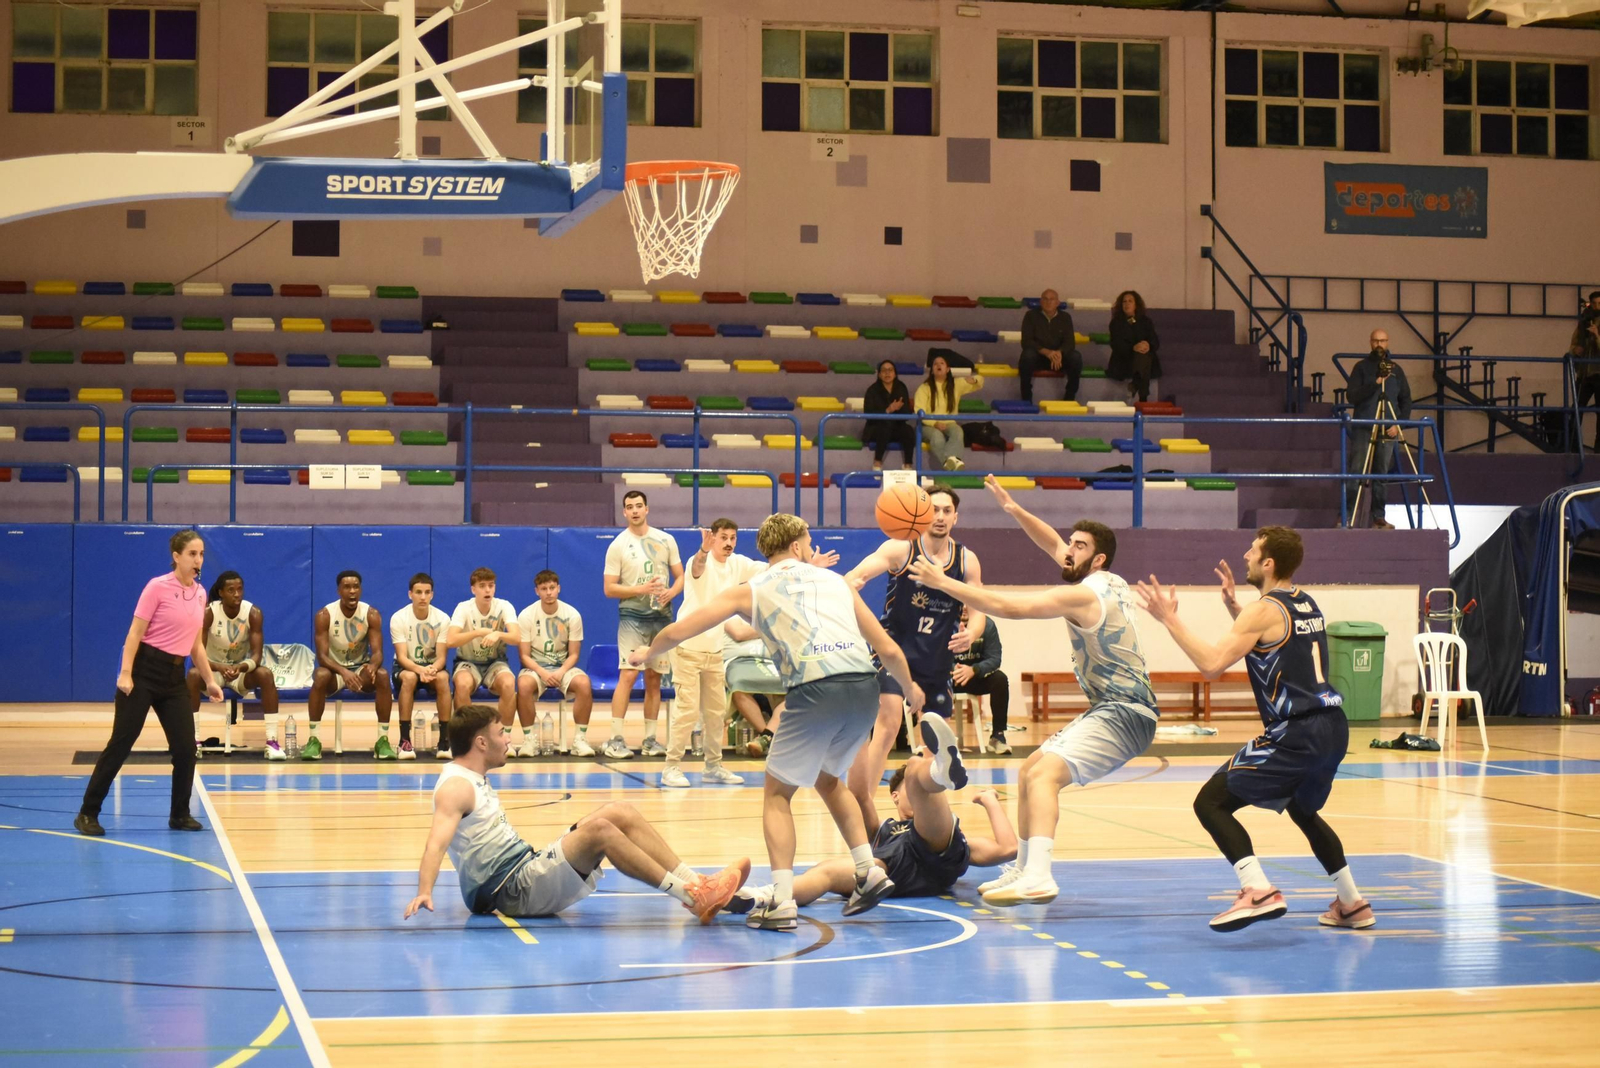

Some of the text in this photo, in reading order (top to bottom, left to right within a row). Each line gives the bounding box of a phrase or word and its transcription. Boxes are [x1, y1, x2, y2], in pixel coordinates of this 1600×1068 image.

[187, 130, 194, 141] 1
[816, 137, 844, 145] SECTOR
[826, 146, 834, 157] 2
[1336, 185, 1452, 214] deportes
[917, 616, 935, 634] 12
[813, 641, 855, 655] FitoSur
[1311, 641, 1326, 684] 1
